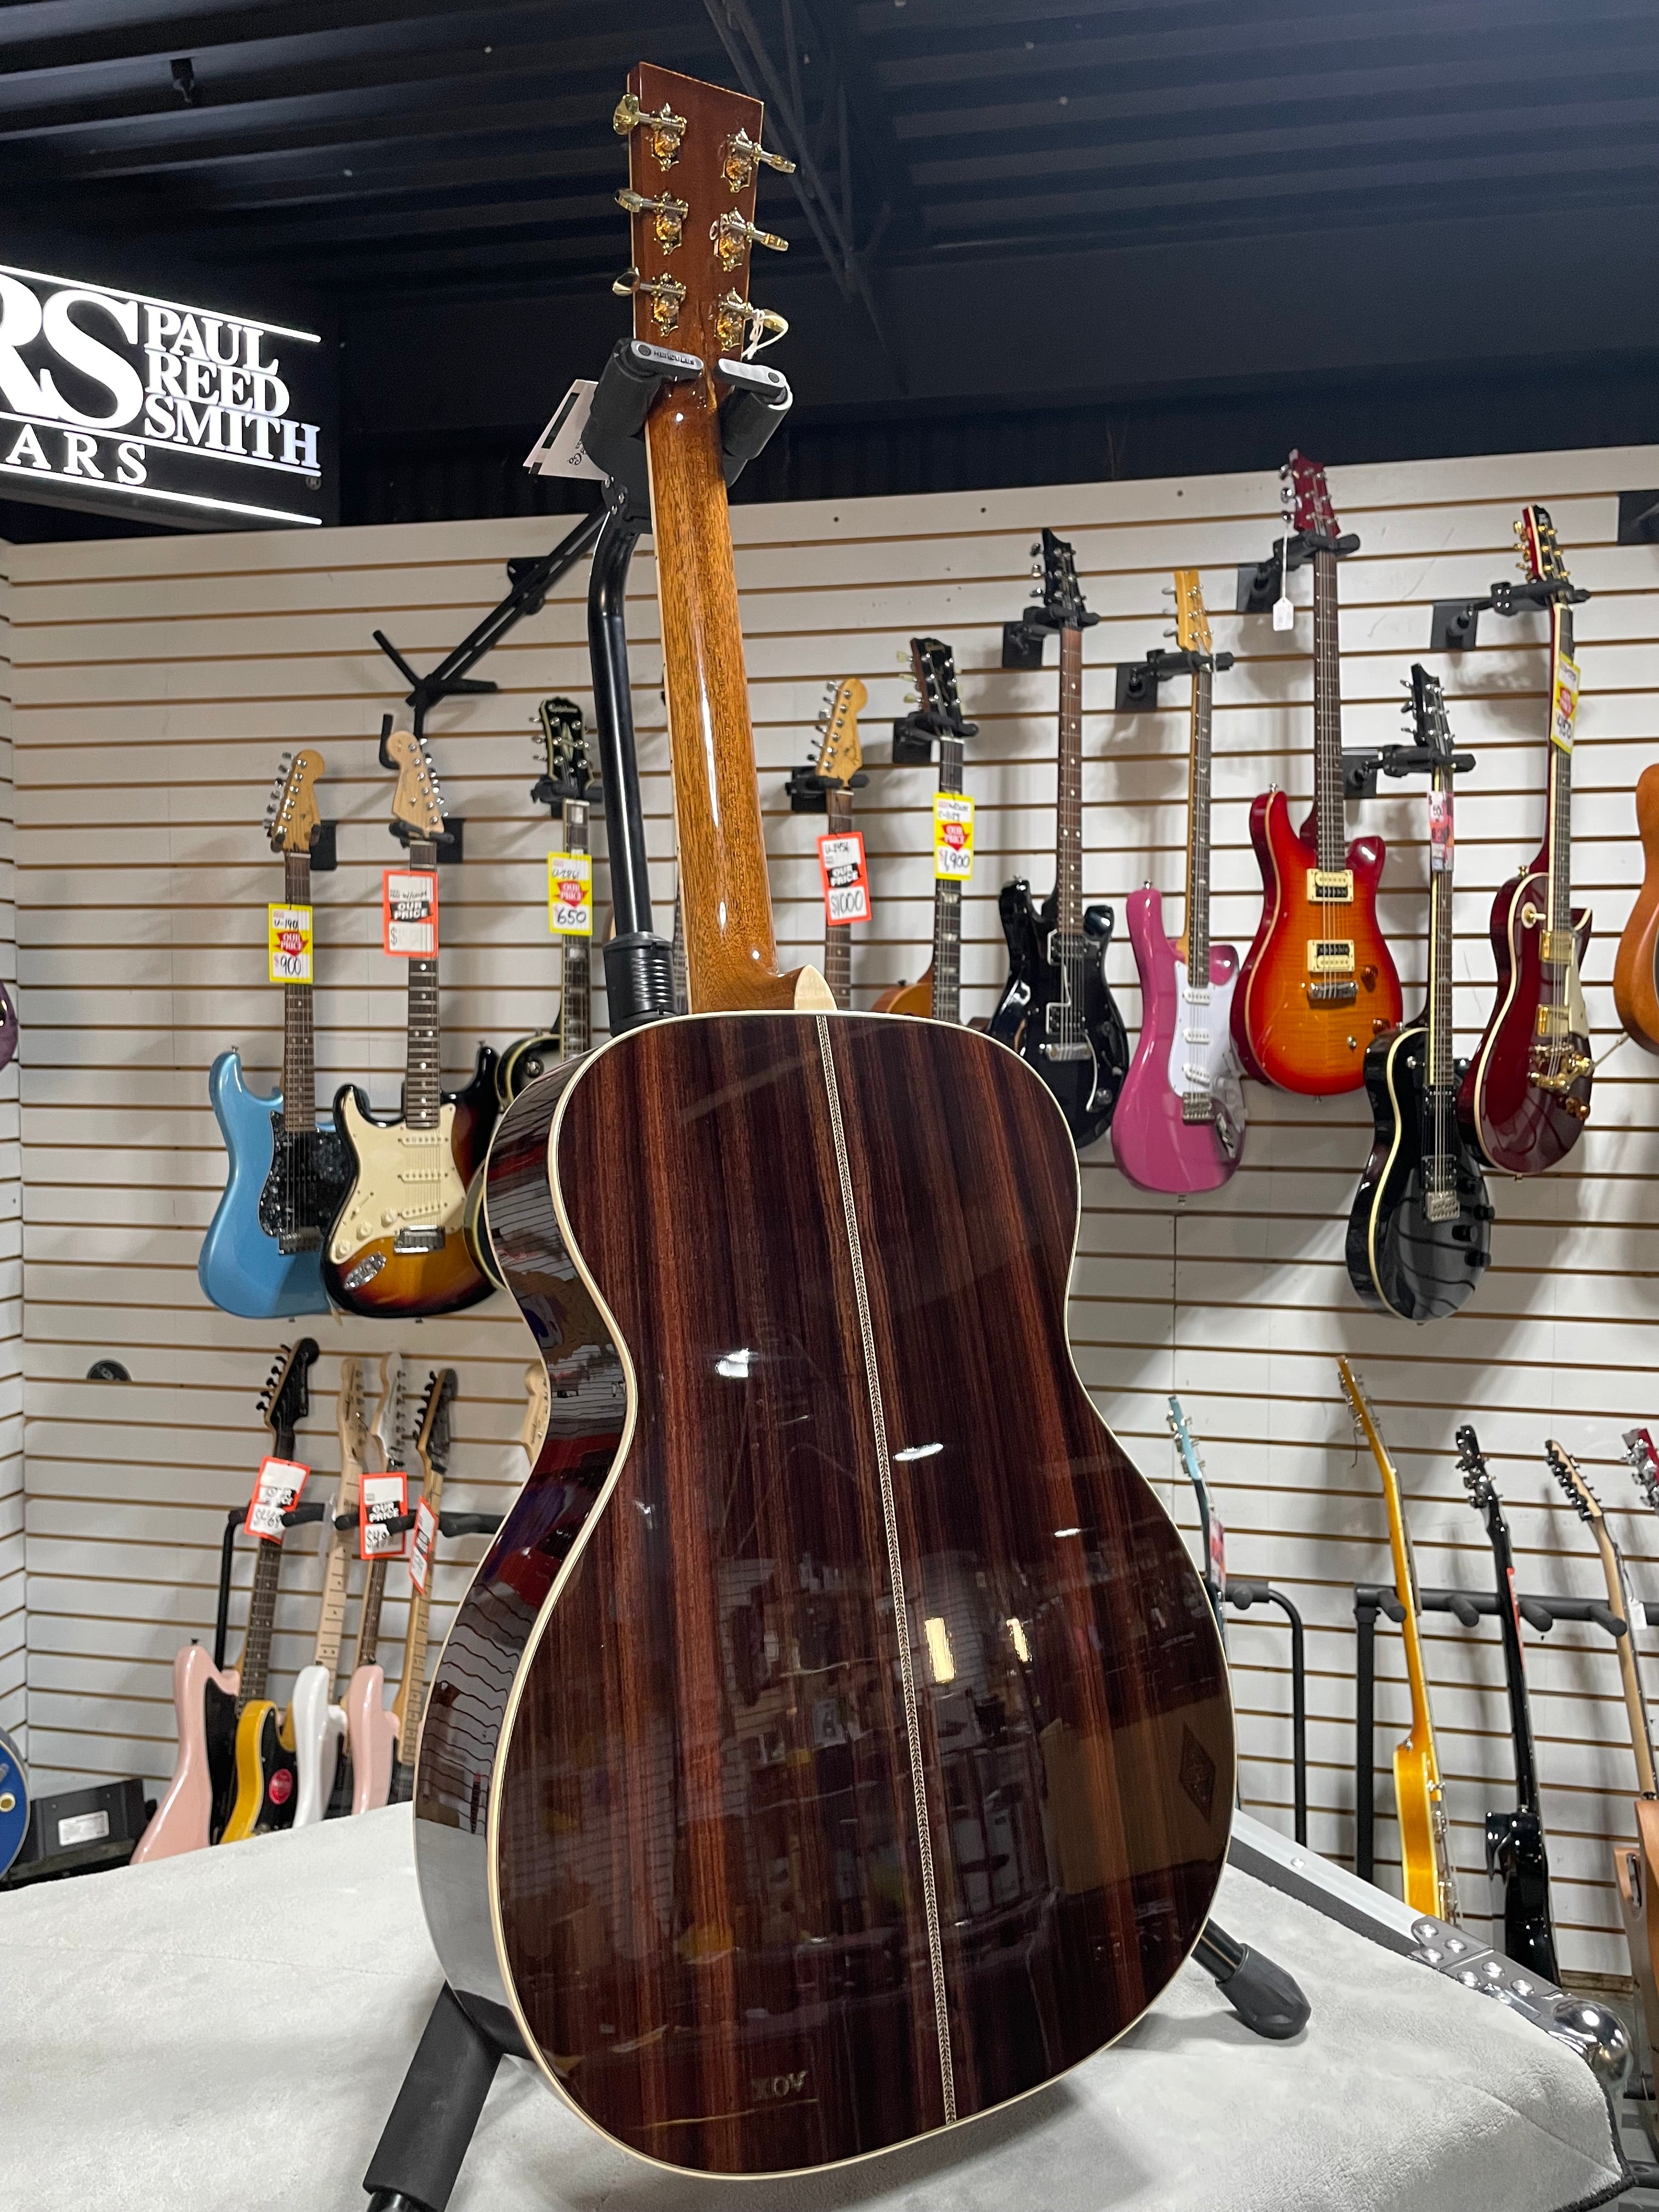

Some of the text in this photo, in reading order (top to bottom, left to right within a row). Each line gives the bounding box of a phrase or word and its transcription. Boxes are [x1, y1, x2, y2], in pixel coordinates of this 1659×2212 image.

[143, 303, 279, 376] PAUL
[144, 348, 290, 418] REED
[144, 393, 321, 469] SMITH
[946, 825, 963, 836] OUR
[944, 833, 966, 844] PRICE
[831, 865, 853, 877] OUR
[830, 870, 859, 887] PRICE
[562, 882, 580, 892] OUR
[560, 890, 584, 901] PRICE
[397, 901, 422, 911] OUR
[393, 908, 428, 920] PRICE
[283, 932, 301, 941] OUR
[280, 940, 303, 951] PRICE
[372, 1501, 395, 1513] OUR
[369, 1508, 399, 1523] PRICE
